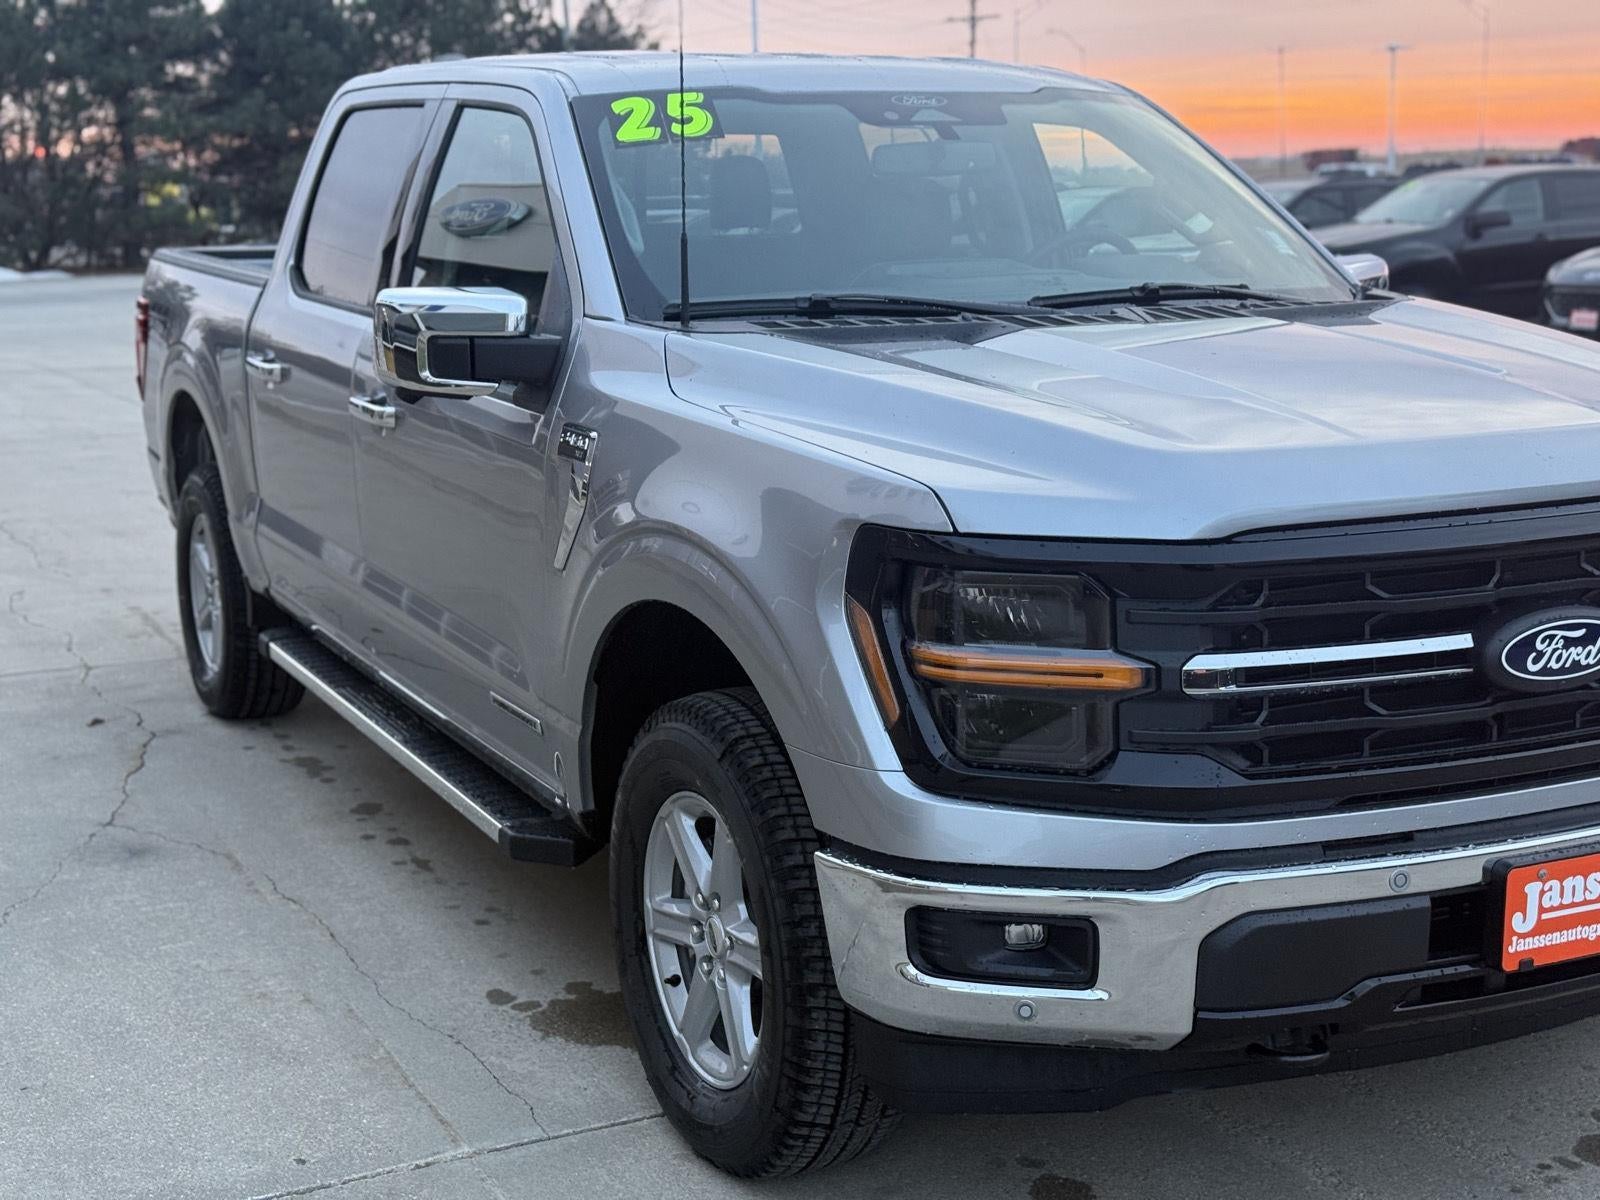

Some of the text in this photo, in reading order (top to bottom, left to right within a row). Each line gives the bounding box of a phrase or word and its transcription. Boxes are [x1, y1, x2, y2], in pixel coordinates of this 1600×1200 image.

[610, 91, 714, 142] 25
[902, 95, 937, 105] Ford
[1526, 628, 1600, 672] Ford
[1511, 872, 1600, 934] Jans
